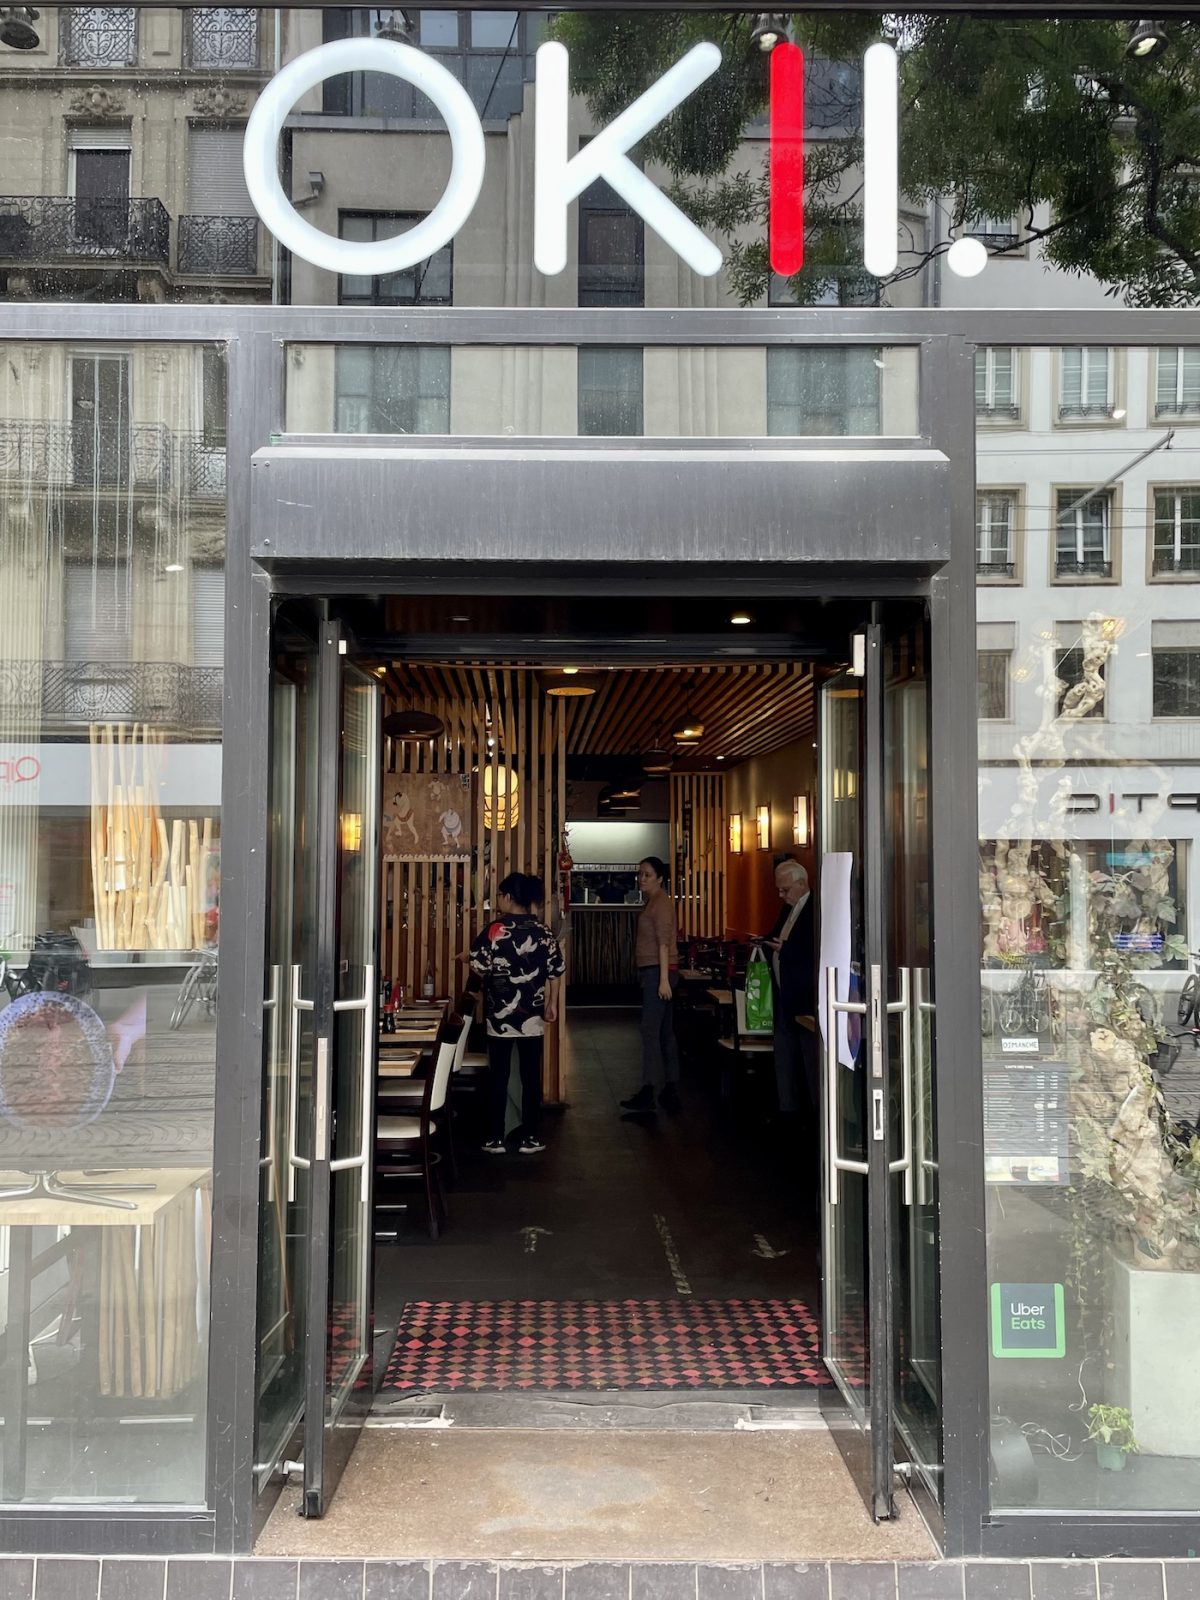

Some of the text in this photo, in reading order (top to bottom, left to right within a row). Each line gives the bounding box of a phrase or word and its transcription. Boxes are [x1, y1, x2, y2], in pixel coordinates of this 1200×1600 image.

[1002, 1041, 1038, 1049] DIMANCHE
[1010, 1302, 1045, 1316] Uber
[1011, 1317, 1046, 1330] Eats
